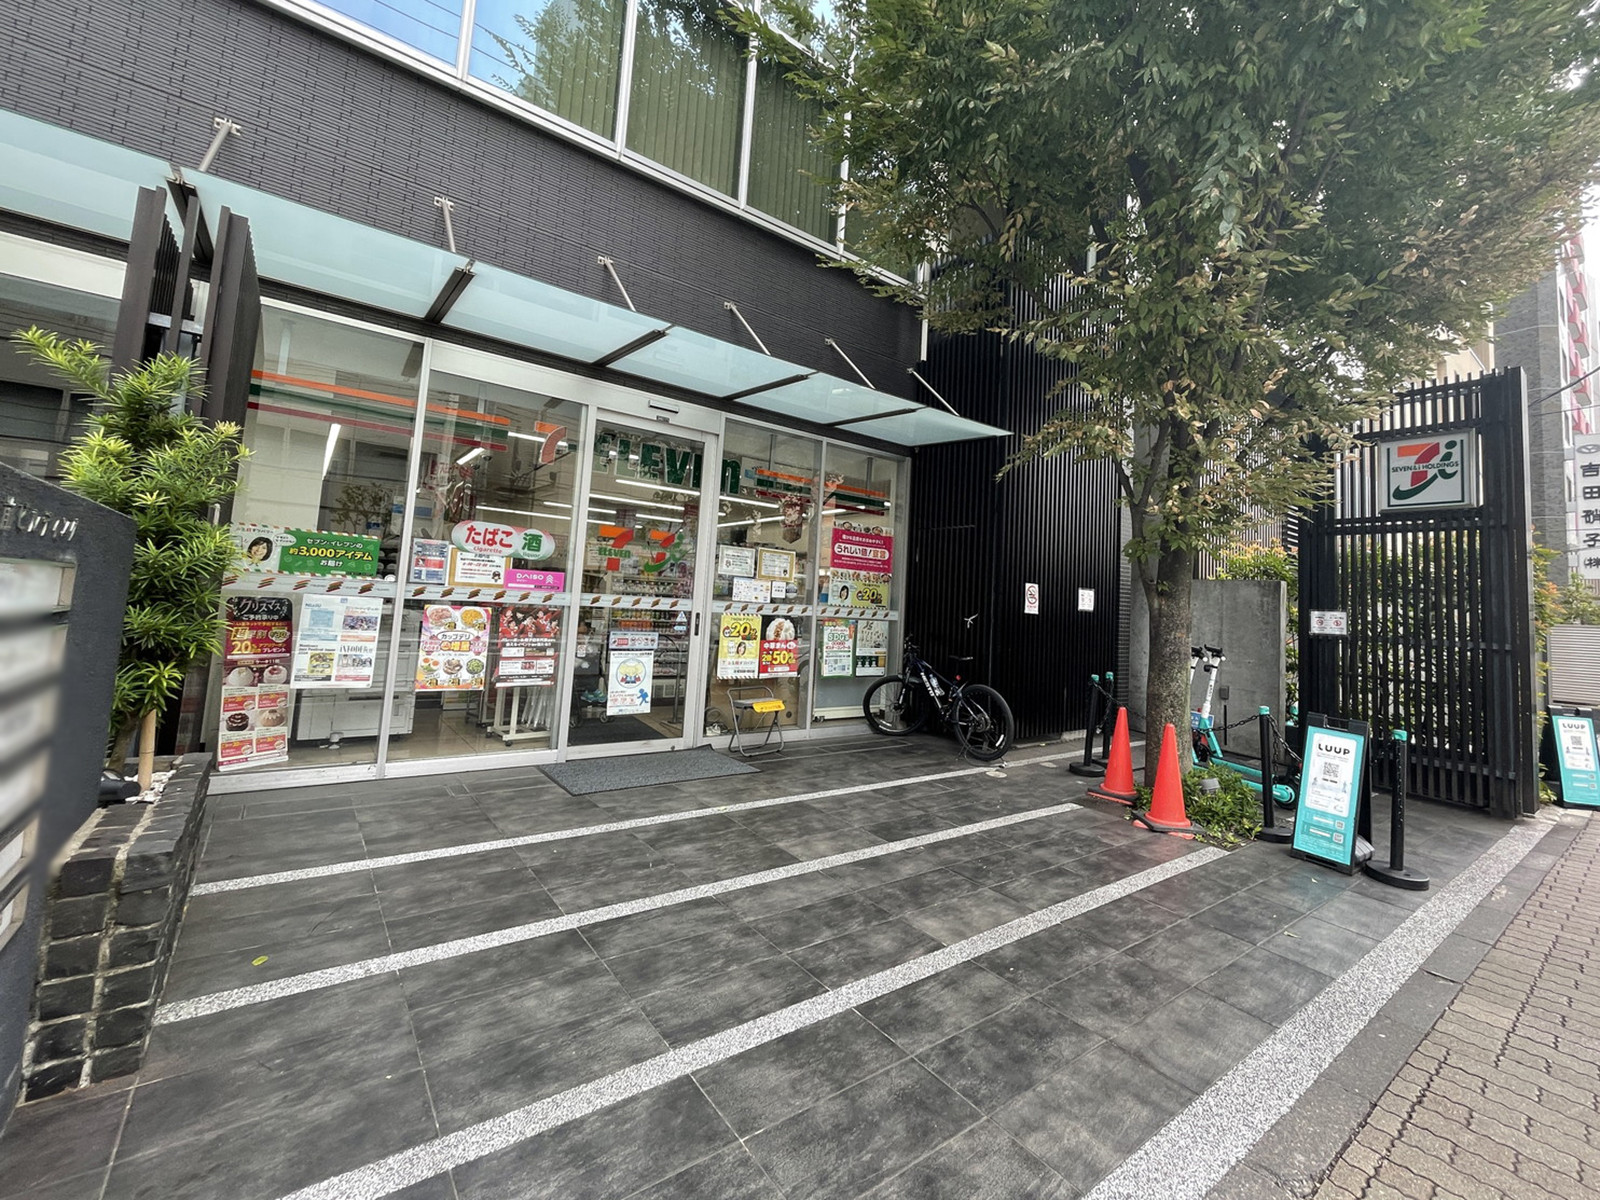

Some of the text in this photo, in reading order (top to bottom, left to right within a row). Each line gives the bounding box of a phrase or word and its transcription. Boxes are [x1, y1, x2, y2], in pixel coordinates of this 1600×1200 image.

[1422, 460, 1459, 470] HOLDINGS
[464, 524, 544, 553] たばこ 酒
[288, 546, 373, 560] 約3,000アイテム
[516, 573, 544, 581] DAISO
[239, 598, 282, 615] クリスマス
[1318, 743, 1351, 756] LUUP
